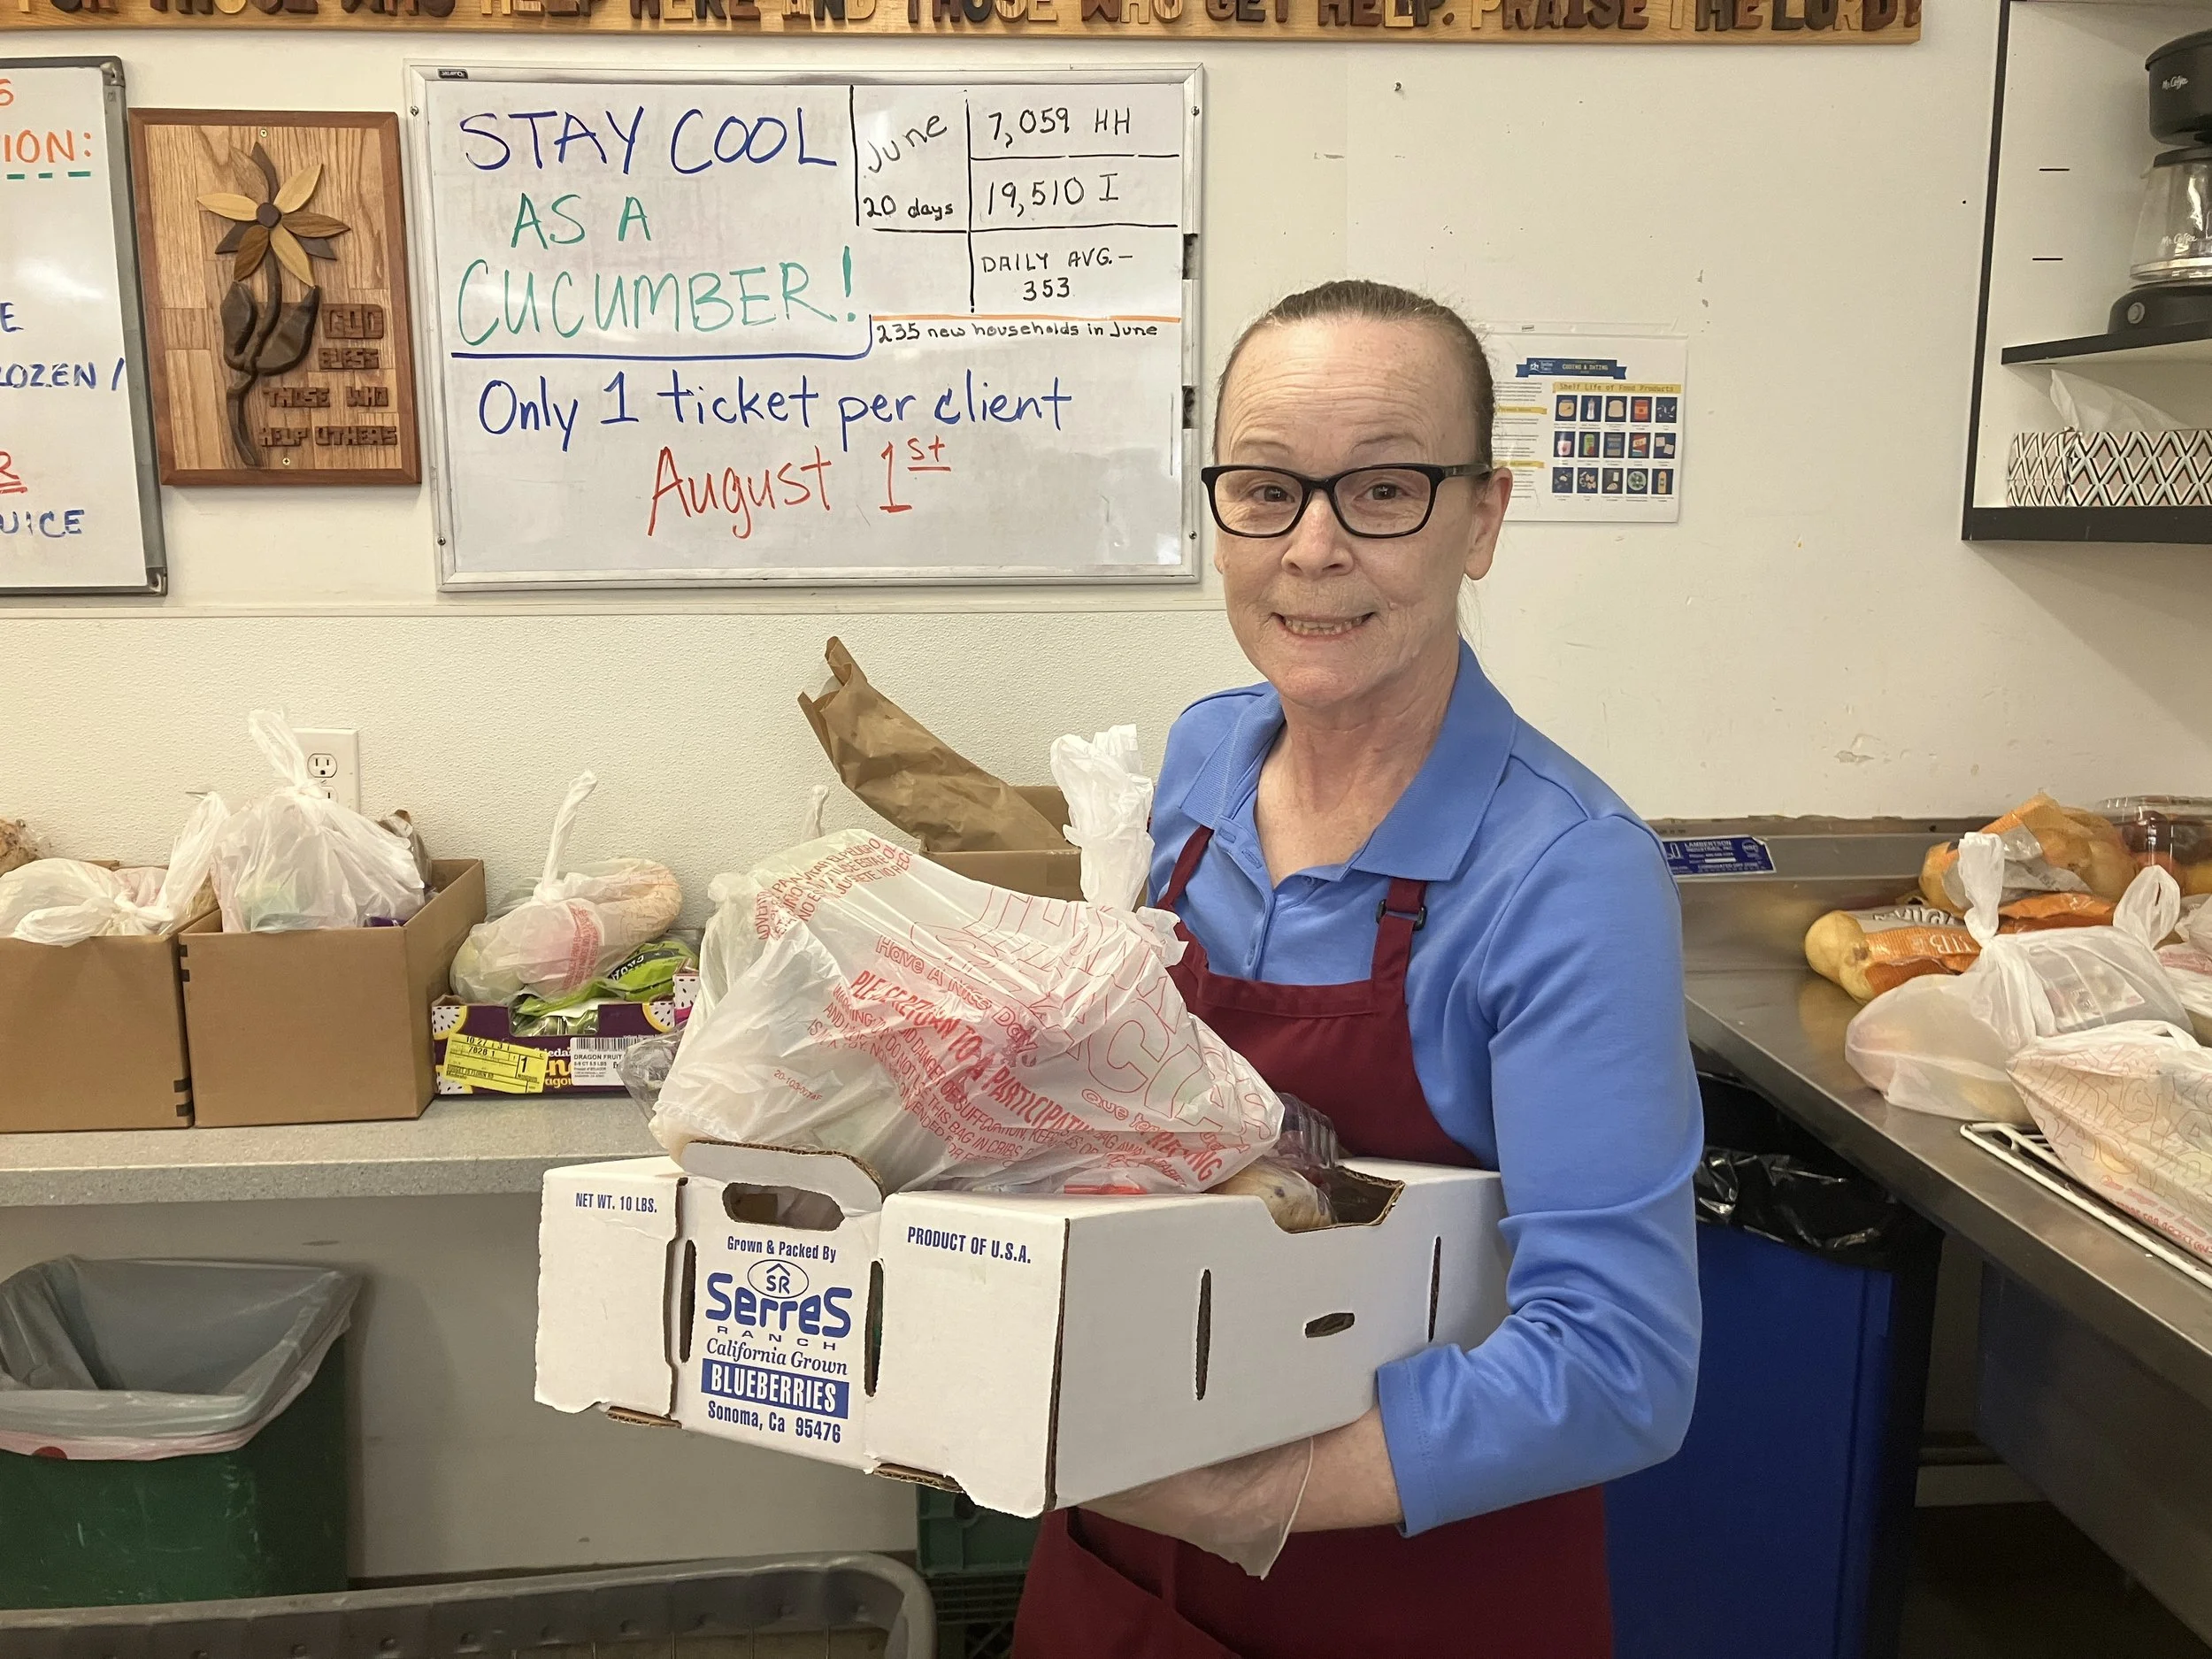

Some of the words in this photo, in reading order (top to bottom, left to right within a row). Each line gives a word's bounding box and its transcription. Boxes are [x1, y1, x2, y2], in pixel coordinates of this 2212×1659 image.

[460, 106, 645, 175] STAY
[671, 107, 837, 174] COOL
[866, 114, 948, 173] June
[987, 107, 1071, 149] 7,059
[1094, 107, 1131, 135] HH
[863, 195, 896, 218] 20
[908, 198, 954, 220] days
[987, 176, 1085, 218] 19,510
[511, 192, 586, 250] AS
[618, 196, 651, 242] A
[981, 251, 1049, 273] DAILY
[457, 245, 856, 347] CUCUMBER!
[1022, 276, 1071, 302] 353
[876, 321, 921, 344] 235
[926, 325, 966, 337] new
[972, 322, 1079, 337] households
[1087, 322, 1104, 337] in
[1109, 323, 1158, 338] June
[0, 361, 96, 389] OZEN
[263, 387, 331, 408] THOSE
[346, 385, 389, 408] WHO
[478, 378, 579, 453] Only
[600, 371, 640, 425] 1
[655, 369, 820, 429] ticket
[837, 392, 917, 451] per
[933, 368, 1073, 430] client
[259, 426, 309, 448] HELP
[314, 425, 398, 446] OTHERS
[647, 444, 833, 538] August
[875, 934, 926, 974] Have
[926, 965, 946, 987] A
[948, 1025, 984, 1062] TO
[927, 1093, 953, 1125] THIS
[948, 1120, 976, 1144] BAG
[1082, 1088, 1129, 1121] Que
[575, 1192, 594, 1209] NET
[597, 1194, 616, 1210] WT.
[619, 1195, 633, 1211] 10
[635, 1196, 657, 1213] LBS.
[726, 1235, 764, 1255] Grown
[765, 1240, 776, 1255] &
[778, 1240, 819, 1261] Packed
[822, 1246, 838, 1264] By
[907, 1225, 966, 1253] PRODUCT
[970, 1236, 987, 1256] OF
[990, 1240, 1032, 1264] U.S.A.
[765, 1275, 791, 1295] SR
[706, 1337, 787, 1367] California
[790, 1350, 849, 1377] Grown
[716, 1325, 837, 1352] RANCH
[710, 1362, 838, 1414] BLUEBERRIES
[707, 1400, 764, 1432] Sonoma,
[768, 1412, 787, 1432] Ca
[795, 1416, 841, 1445] 95476
